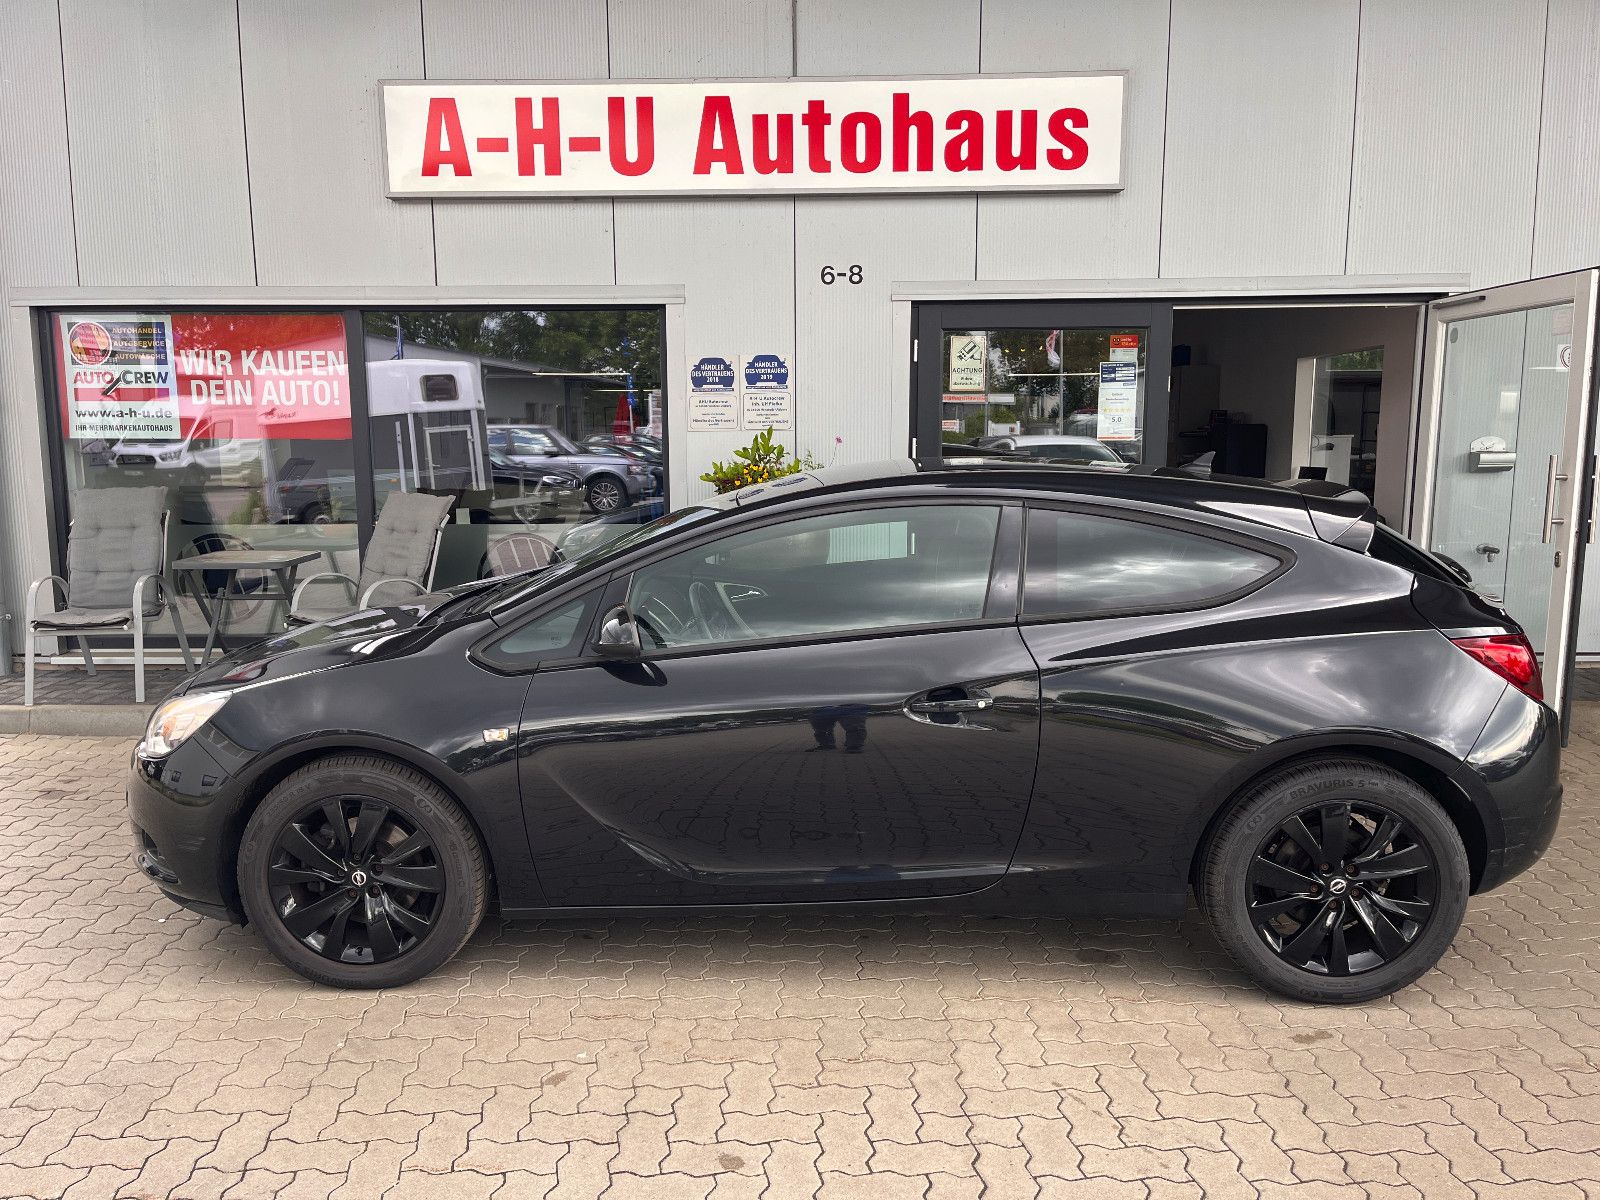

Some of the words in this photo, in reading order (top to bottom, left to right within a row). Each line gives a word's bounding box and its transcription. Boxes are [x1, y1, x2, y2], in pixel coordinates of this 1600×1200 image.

[421, 97, 655, 176] A-H-U
[693, 93, 1089, 175] Autohaus
[820, 265, 864, 285] 6-8
[179, 349, 234, 376] WIR
[241, 349, 346, 376] KAUFEN
[73, 371, 115, 385] AUTO
[121, 370, 169, 384] CREW
[190, 379, 253, 406] DEIN
[261, 380, 340, 406] AUTO!
[75, 408, 173, 418] www.a-h-u.de
[89, 424, 173, 432] MEHRMARKENAUTOHAUS
[1290, 779, 1354, 800] BRAVURIS
